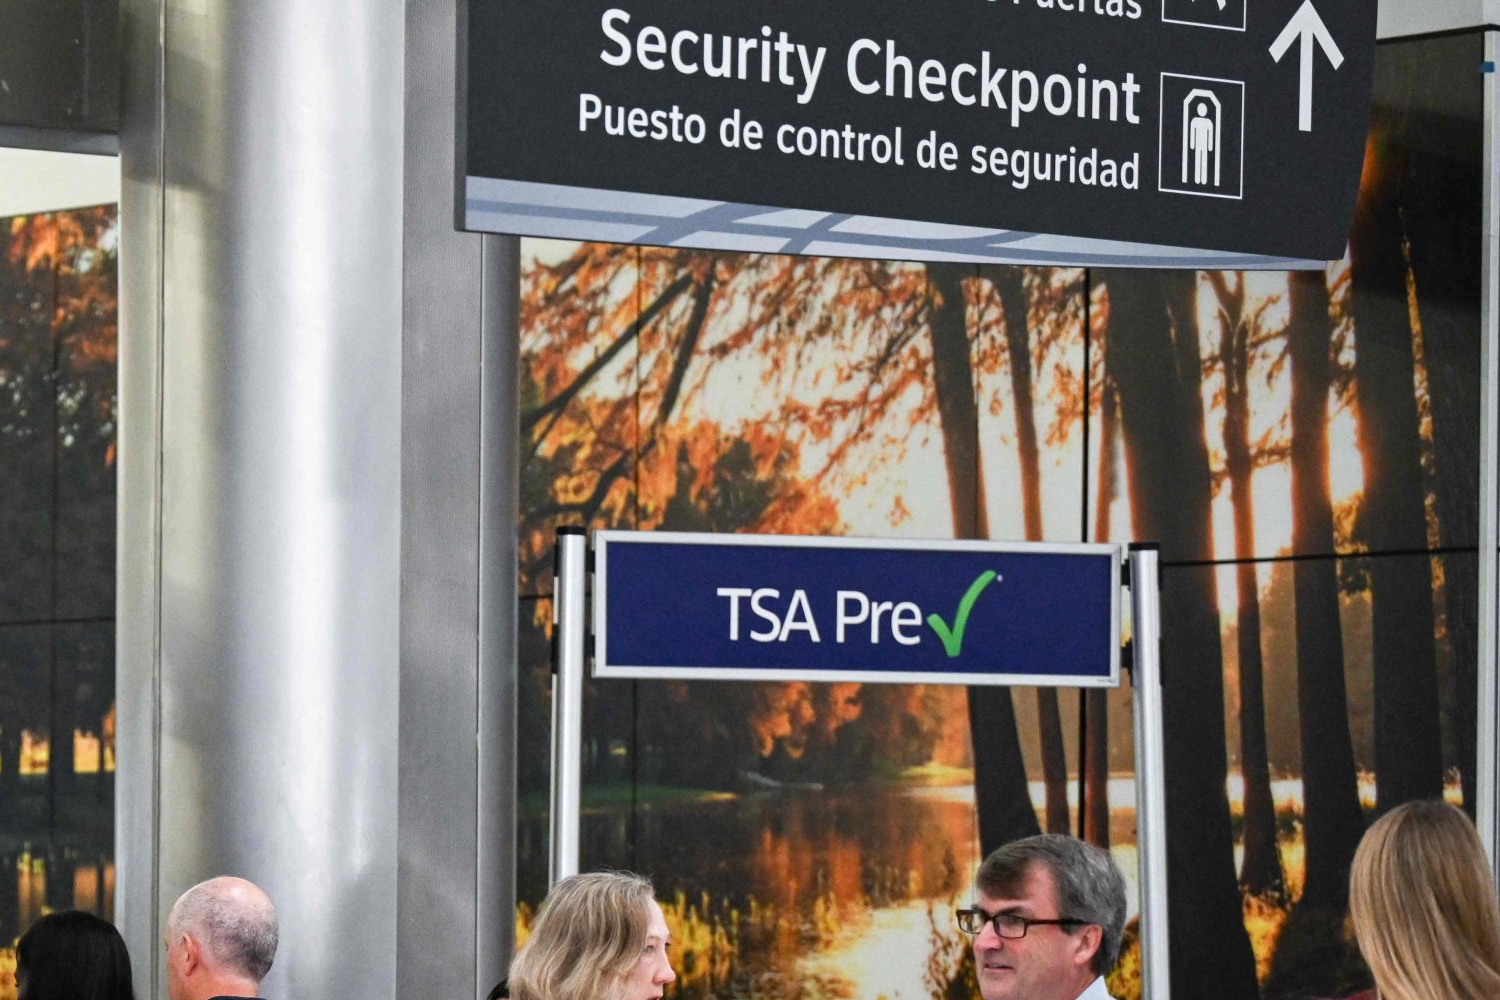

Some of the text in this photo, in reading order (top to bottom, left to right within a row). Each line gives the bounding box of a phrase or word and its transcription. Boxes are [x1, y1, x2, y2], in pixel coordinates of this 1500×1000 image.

[599, 8, 1141, 128] Security Checkpoint
[579, 93, 1140, 190] Puesto de control de seguridad
[716, 587, 923, 646] TSA Pre
